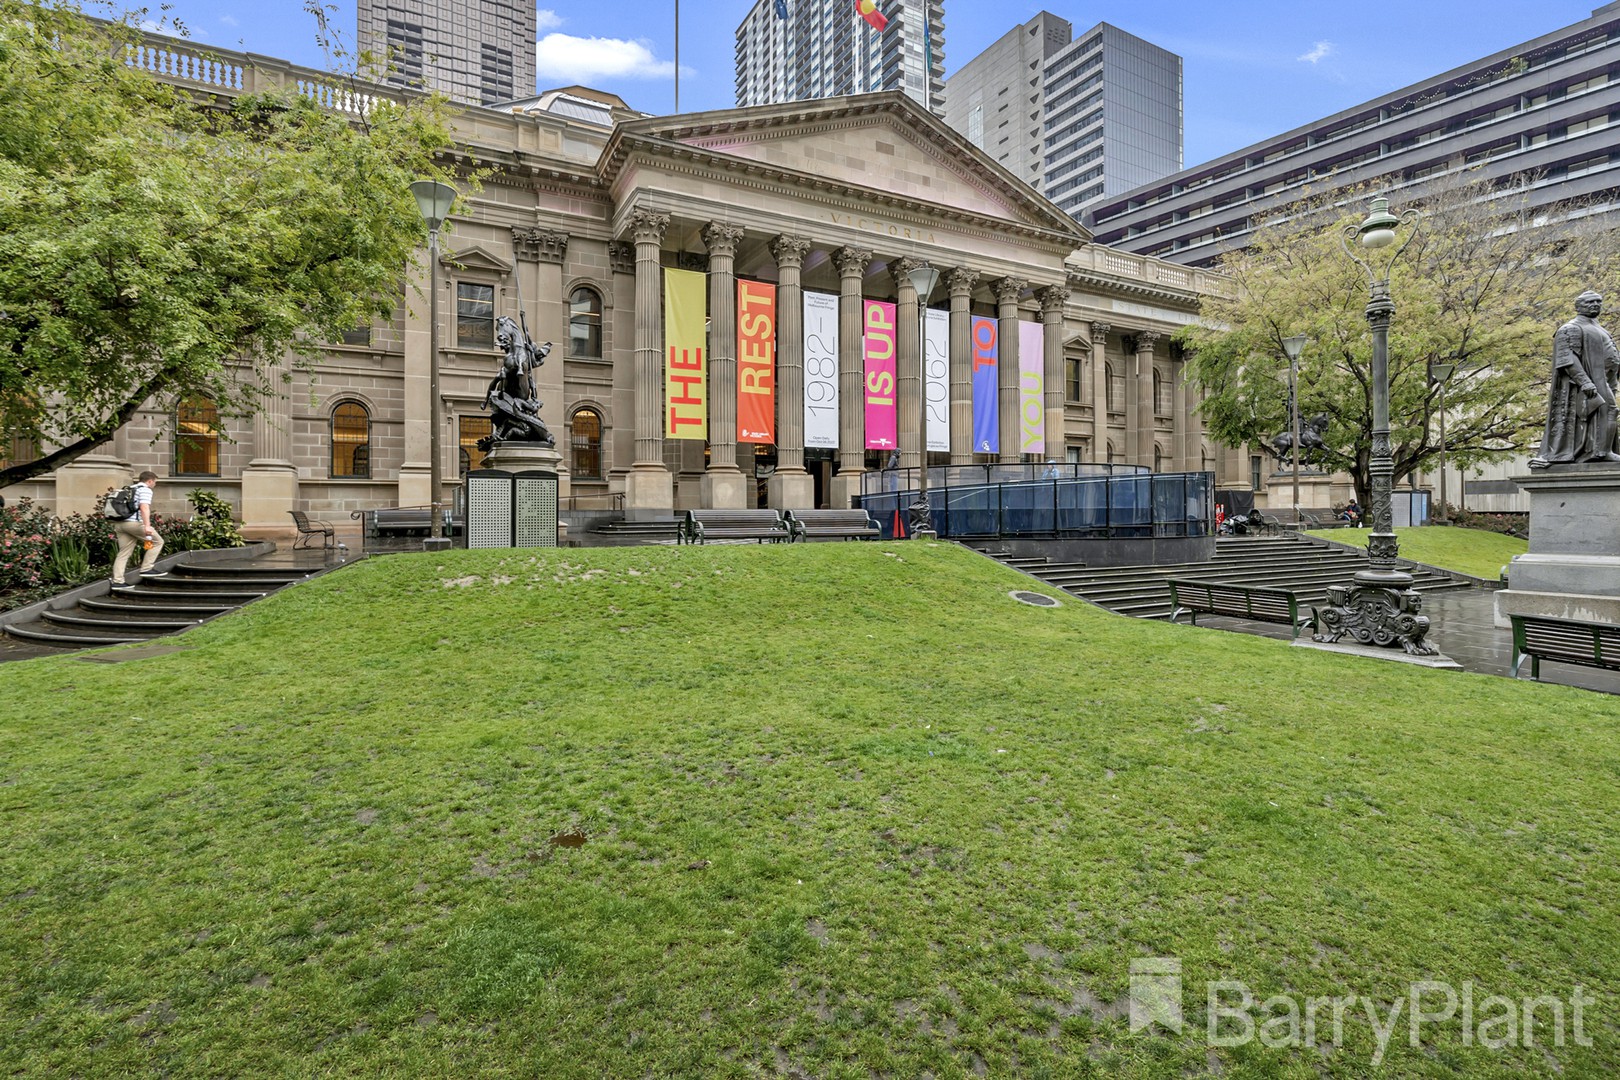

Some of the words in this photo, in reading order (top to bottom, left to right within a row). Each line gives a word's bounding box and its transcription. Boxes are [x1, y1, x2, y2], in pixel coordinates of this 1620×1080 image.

[830, 212, 936, 243] VICTORIA
[866, 304, 893, 360] UP
[1118, 301, 1157, 317] STATE
[741, 285, 772, 395] REST
[973, 320, 997, 373] TO
[670, 346, 702, 434] THE
[866, 370, 893, 406] IS
[925, 338, 947, 424] 2062
[1022, 371, 1043, 449] YOU
